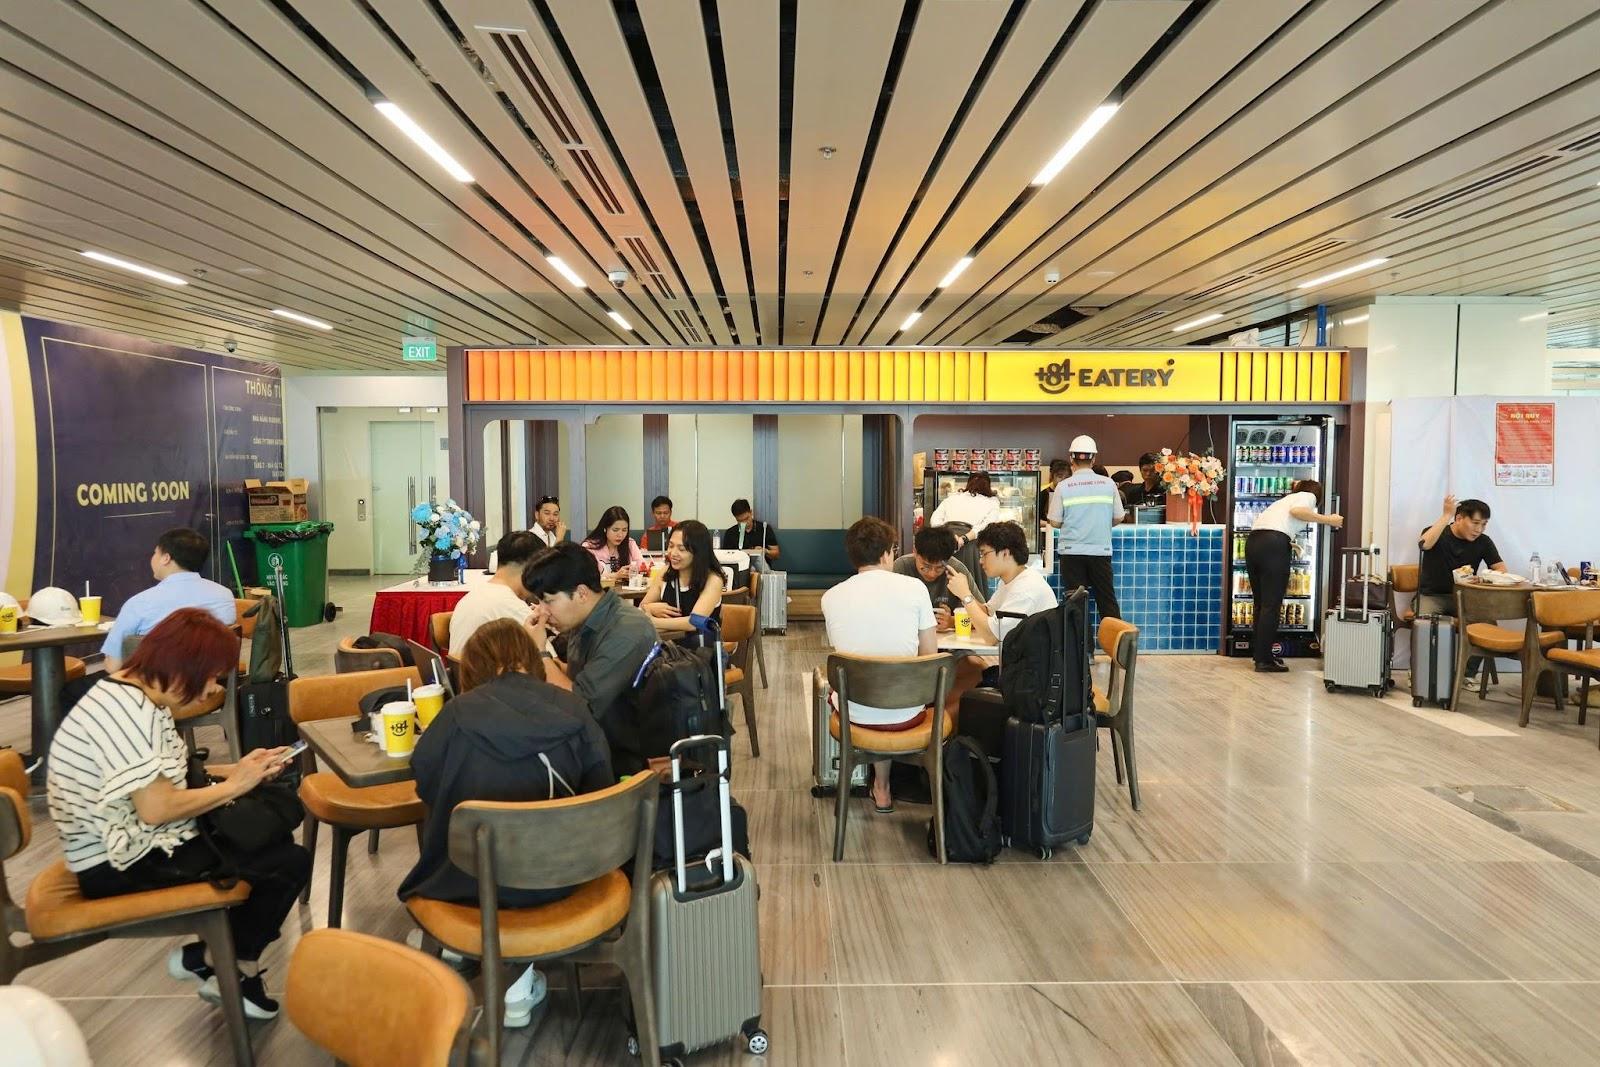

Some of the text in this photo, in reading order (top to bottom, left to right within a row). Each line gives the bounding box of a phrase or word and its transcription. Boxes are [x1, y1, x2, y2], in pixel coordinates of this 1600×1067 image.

[408, 346, 430, 358] EXIT
[1035, 358, 1174, 387] +84 EATERY
[245, 377, 273, 397] THÔNG
[76, 481, 190, 506] COMING SOON
